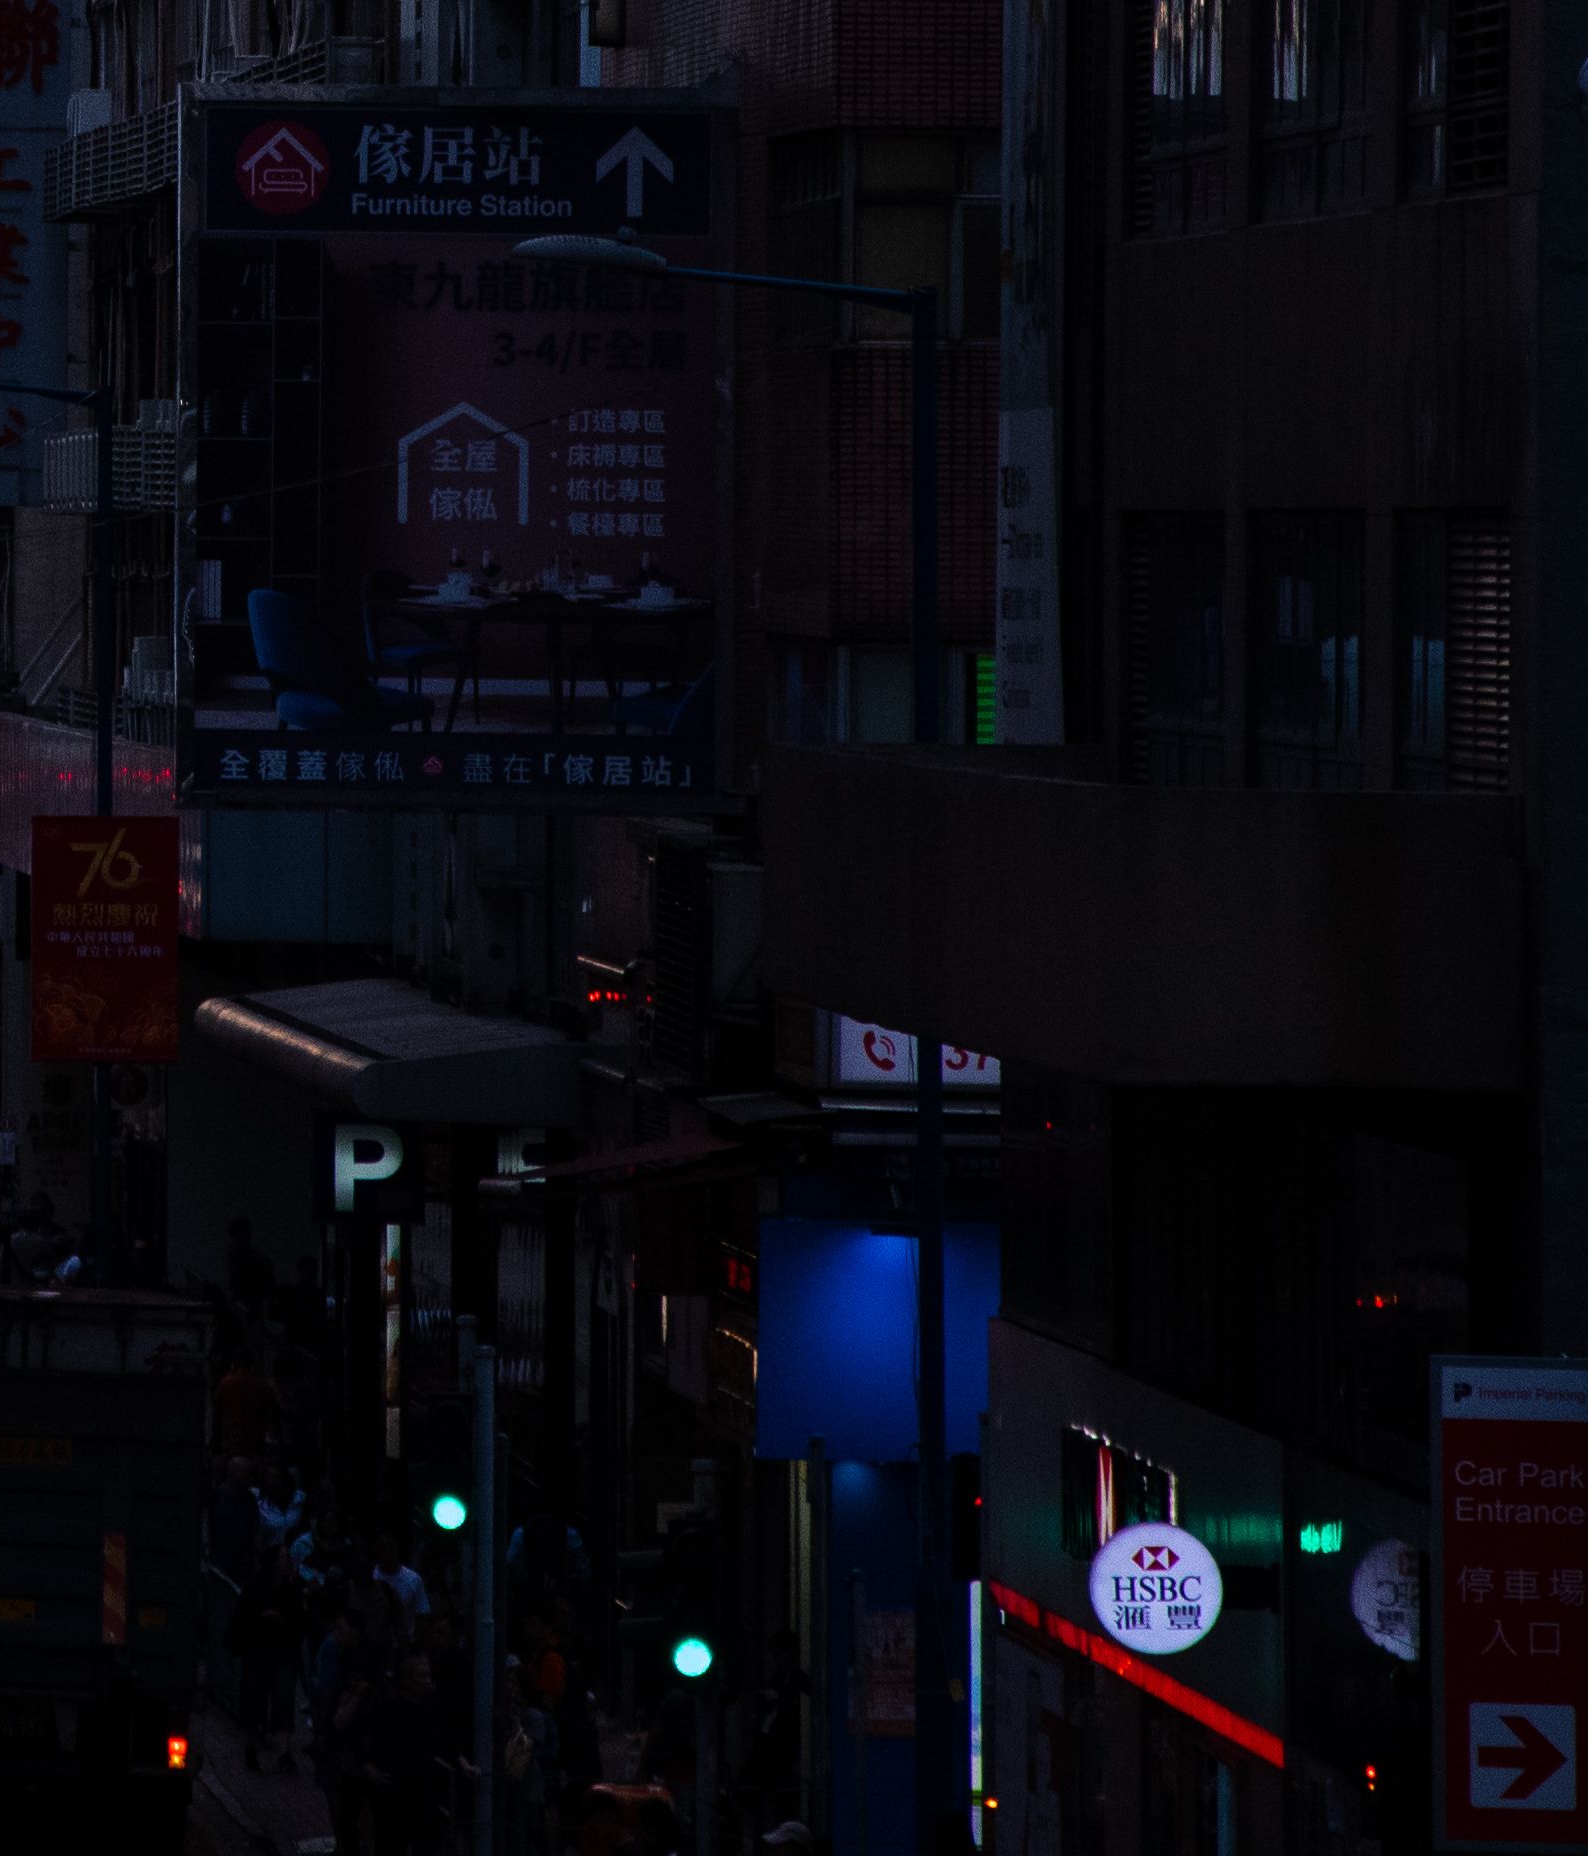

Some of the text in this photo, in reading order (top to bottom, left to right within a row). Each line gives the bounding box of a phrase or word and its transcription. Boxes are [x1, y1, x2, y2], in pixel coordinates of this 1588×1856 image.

[353, 123, 543, 188] 傢居站
[351, 192, 573, 220] Furniture Station
[429, 438, 498, 474] 全屋
[70, 827, 140, 898] 76
[52, 902, 158, 927] 熱烈慶祝
[334, 1122, 404, 1213] P
[1479, 1387, 1532, 1402] Imperial
[1455, 1460, 1586, 1490] Car Park
[1455, 1496, 1586, 1527] Entrance
[1111, 1575, 1203, 1603] HSBC
[1457, 1565, 1587, 1607] 停車場
[1481, 1620, 1561, 1657] 入口
